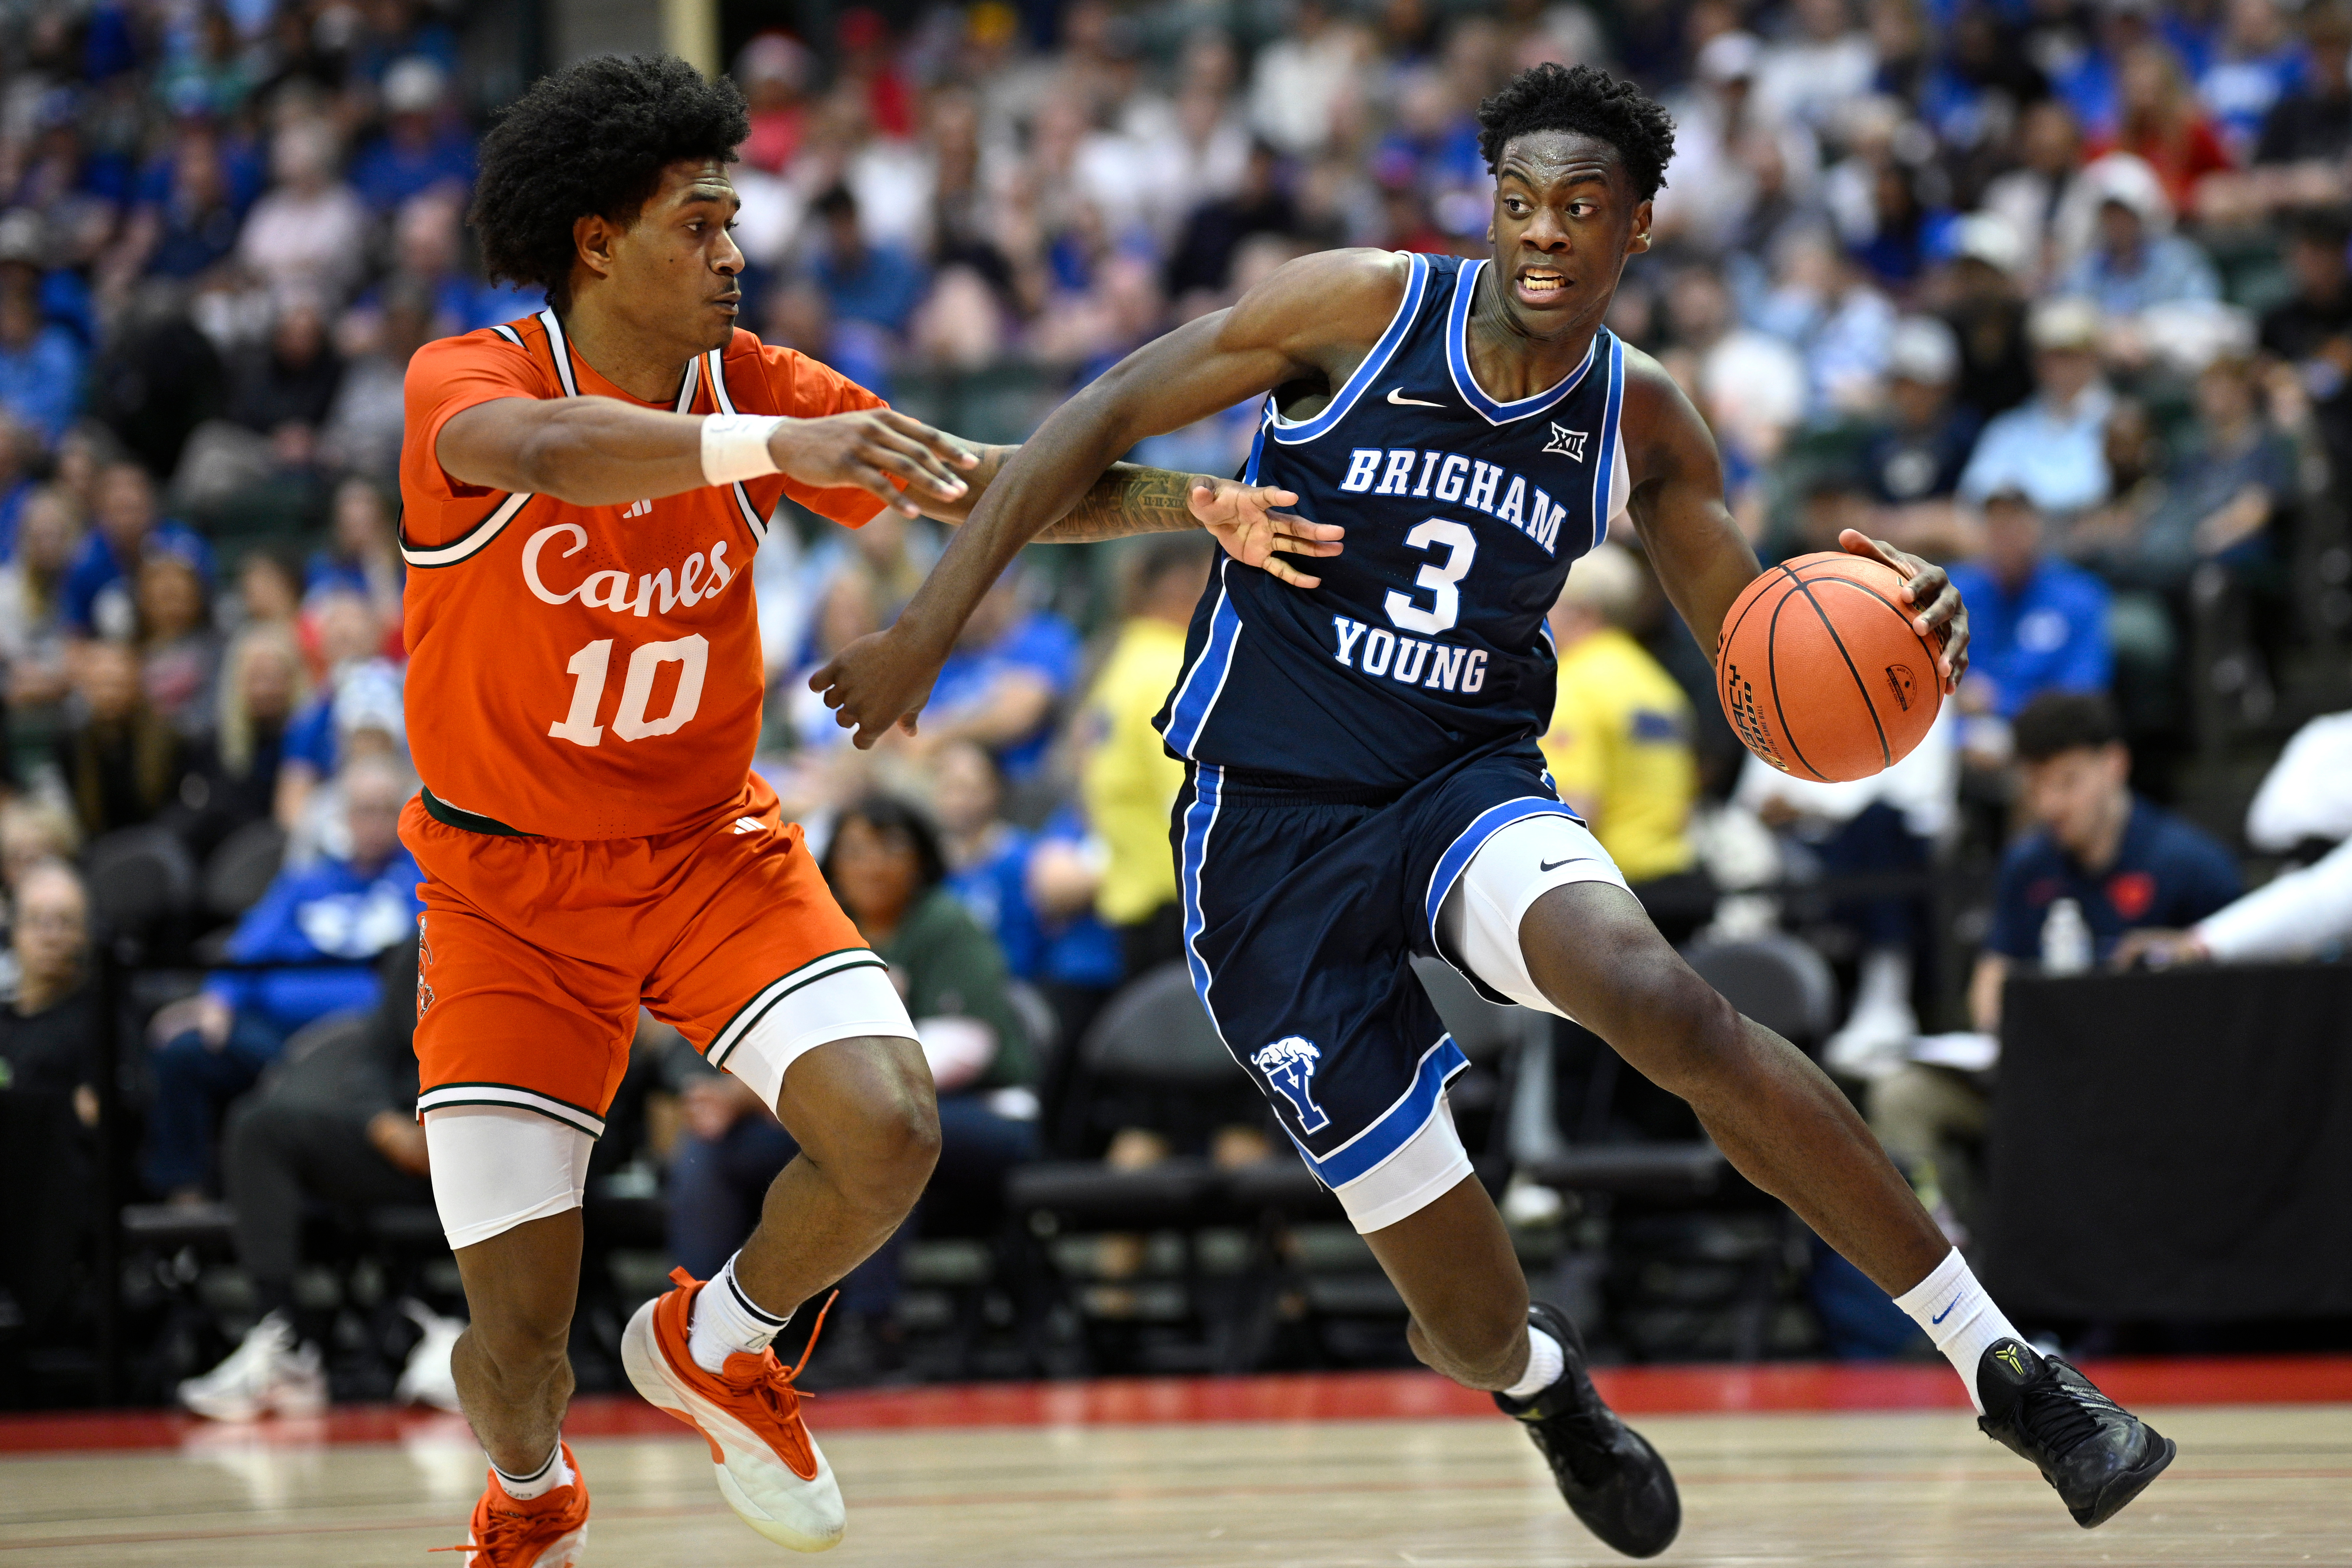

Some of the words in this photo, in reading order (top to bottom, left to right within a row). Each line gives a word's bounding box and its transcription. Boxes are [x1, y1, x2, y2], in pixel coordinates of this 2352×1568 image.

[1338, 448, 1569, 557] BRIGHAM
[522, 523, 736, 617] Canes
[1382, 516, 1478, 635] 3
[548, 633, 709, 747] 10
[1332, 614, 1488, 694] YOUNG
[1744, 681, 1773, 754] 1000
[1757, 705, 1765, 719] BALL
[1762, 722, 1772, 737] GAME
[1768, 738, 1785, 760] OFFICIAL
[1266, 1061, 1330, 1135] Y
